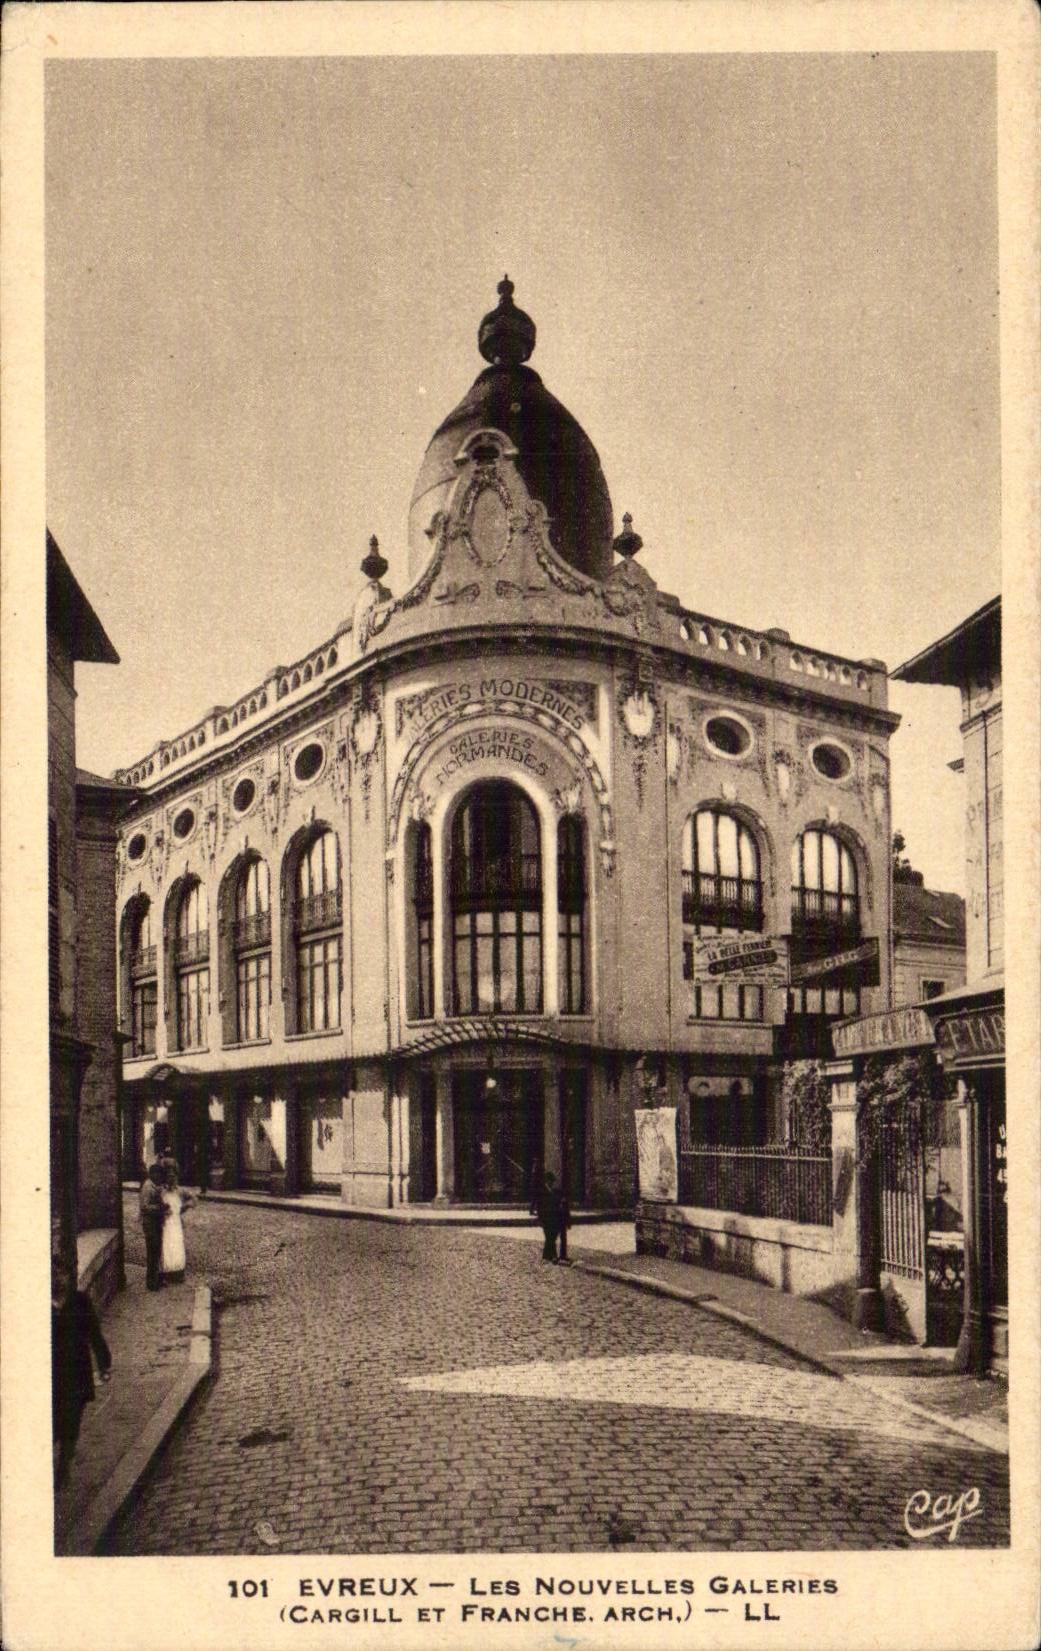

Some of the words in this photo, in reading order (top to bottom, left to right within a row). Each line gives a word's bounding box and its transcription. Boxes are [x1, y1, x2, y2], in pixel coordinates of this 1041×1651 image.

[405, 683, 471, 746] ALERIES
[480, 679, 585, 730] MODERNES
[449, 730, 535, 755] GALERIES
[436, 744, 549, 785] NORMANDES
